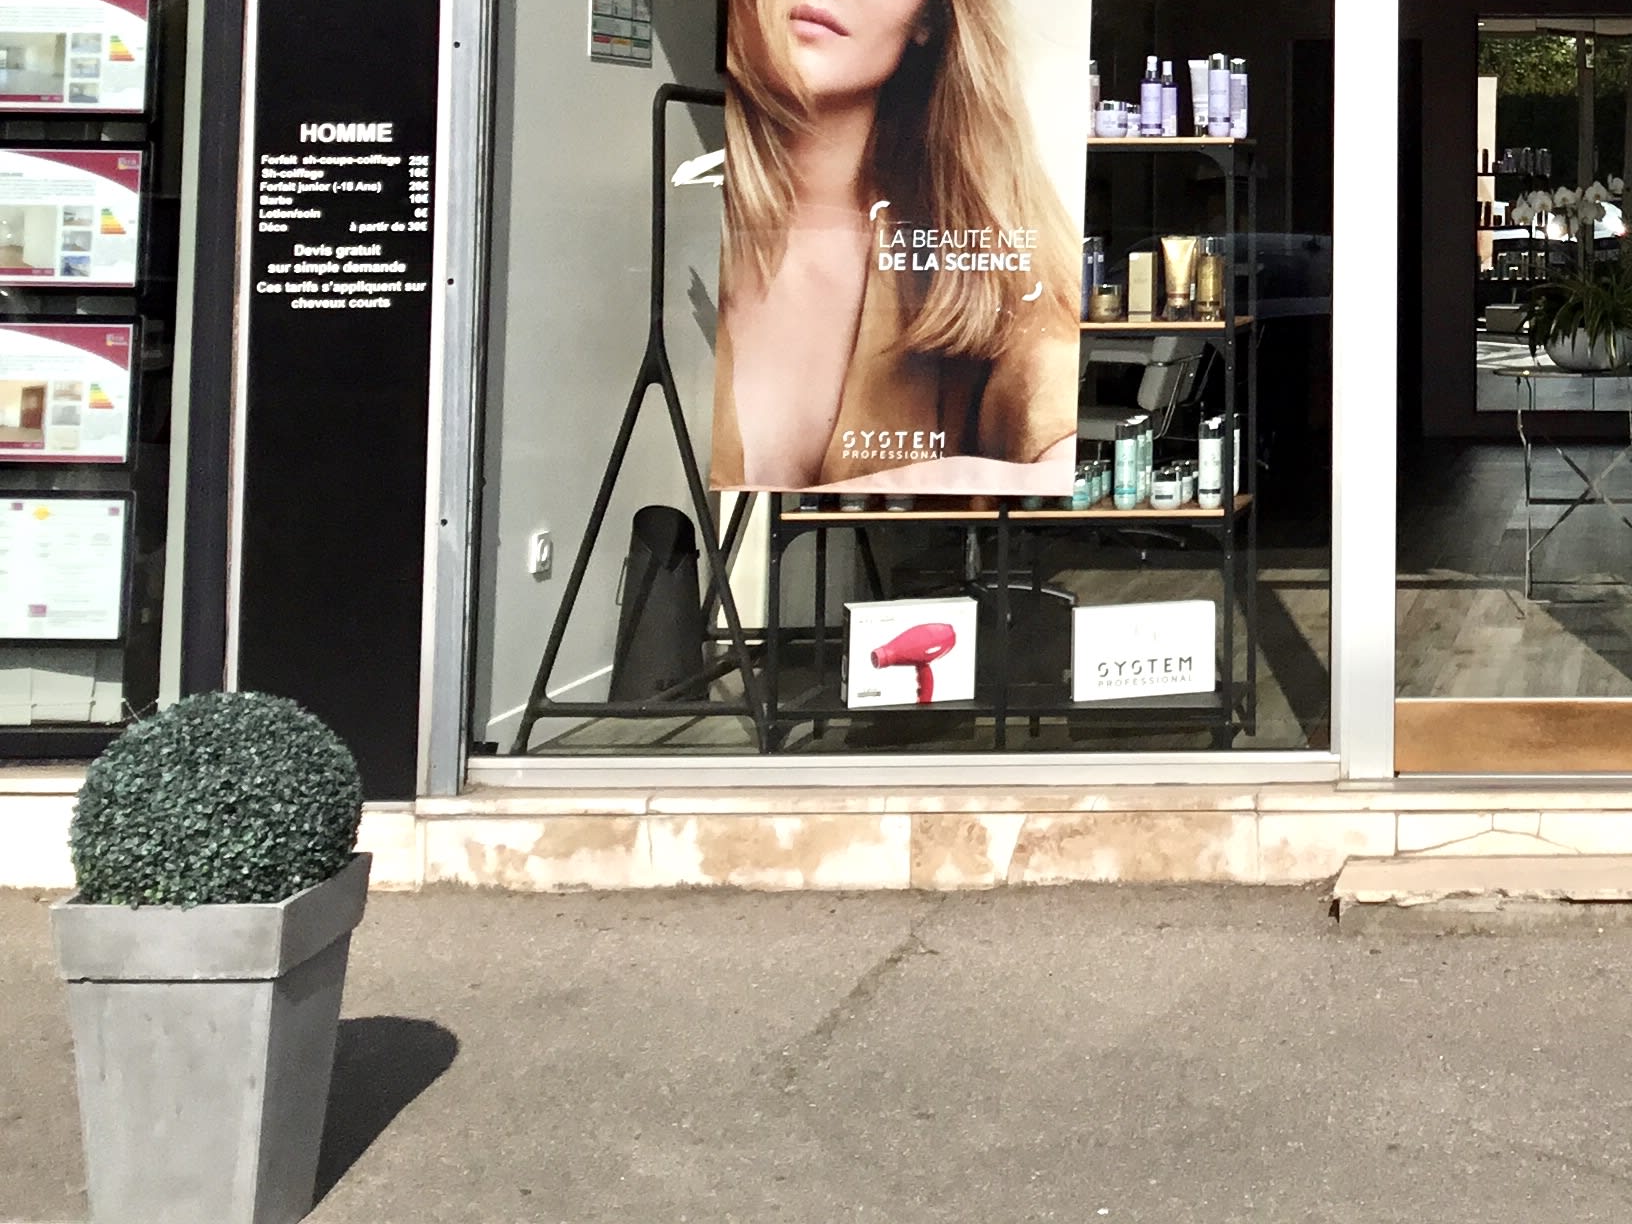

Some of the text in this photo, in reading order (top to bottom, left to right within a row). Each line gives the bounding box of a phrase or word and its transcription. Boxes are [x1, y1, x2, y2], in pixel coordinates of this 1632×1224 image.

[300, 123, 392, 143] HOMME
[261, 155, 297, 164] Forfait
[260, 182, 296, 191] Forfait
[298, 182, 331, 193] junior
[355, 182, 381, 193] Ans)
[260, 195, 292, 205] Barbe
[350, 222, 356, 231] à
[359, 222, 389, 233] partir
[391, 222, 405, 231] de
[879, 227, 1037, 248] LA BEAUTÉ NÉE
[294, 244, 381, 258] Devis gratuit
[268, 261, 406, 275] sur simple demande
[879, 253, 1031, 272] DE LA SCIENCE
[257, 281, 426, 294] Ces tarifs s'appliquent sur
[291, 298, 391, 309] cheveux courts
[842, 431, 945, 448] SYSTEM
[842, 450, 944, 459] PROFESSIONAL
[1098, 656, 1192, 677] SYSTEM
[1098, 675, 1192, 686] PROFESSIONAL
